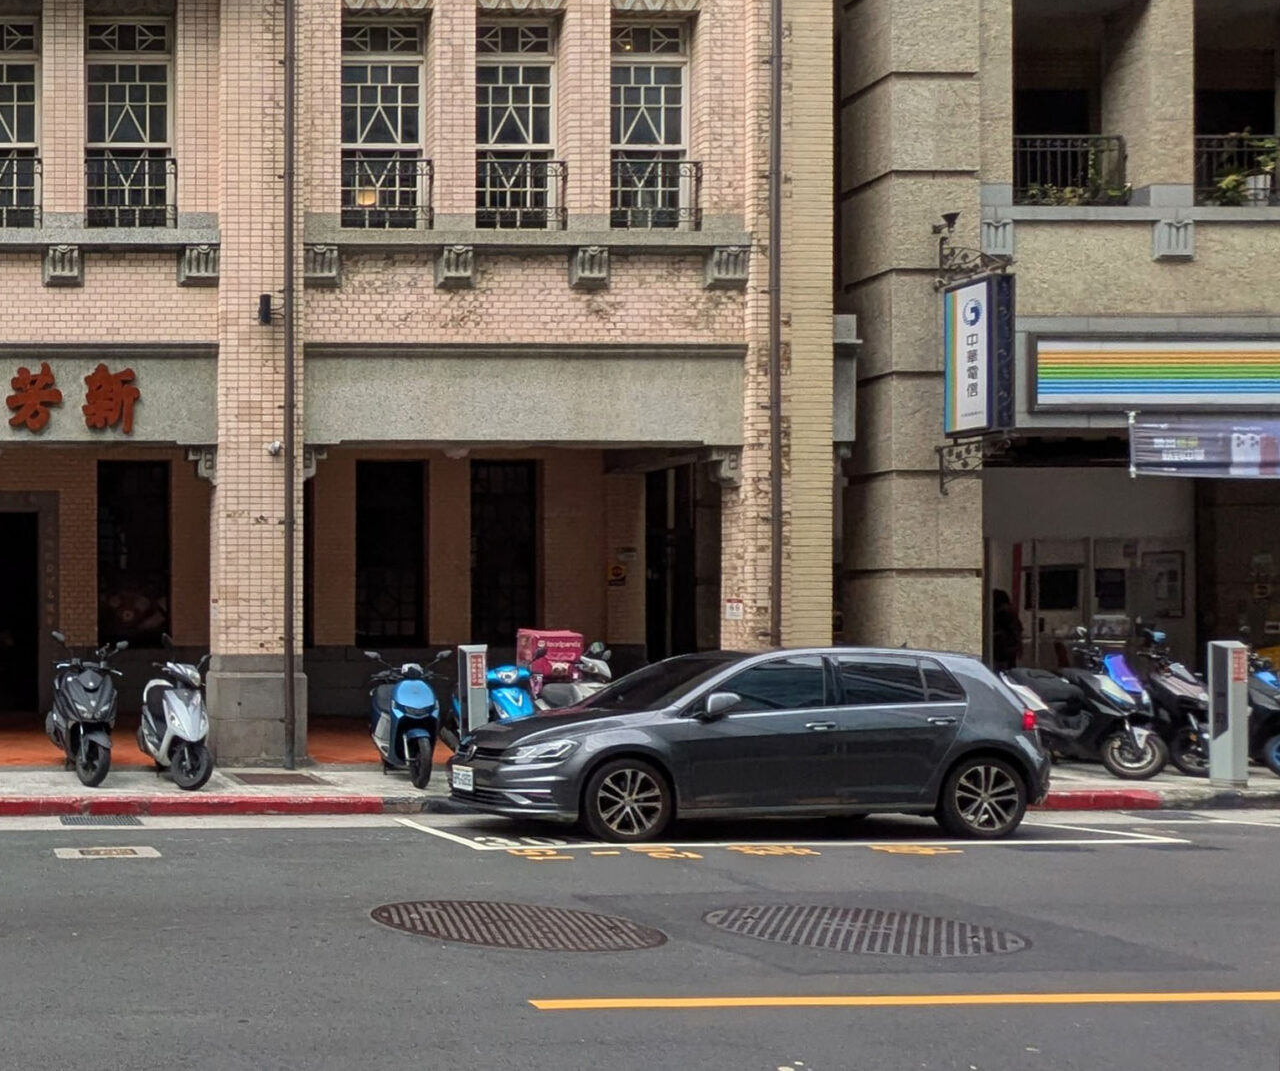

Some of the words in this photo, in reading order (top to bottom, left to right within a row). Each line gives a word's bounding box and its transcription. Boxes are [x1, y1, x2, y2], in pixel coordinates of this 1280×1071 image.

[965, 333, 979, 398] 中華電信
[546, 640, 581, 649] foodpanda
